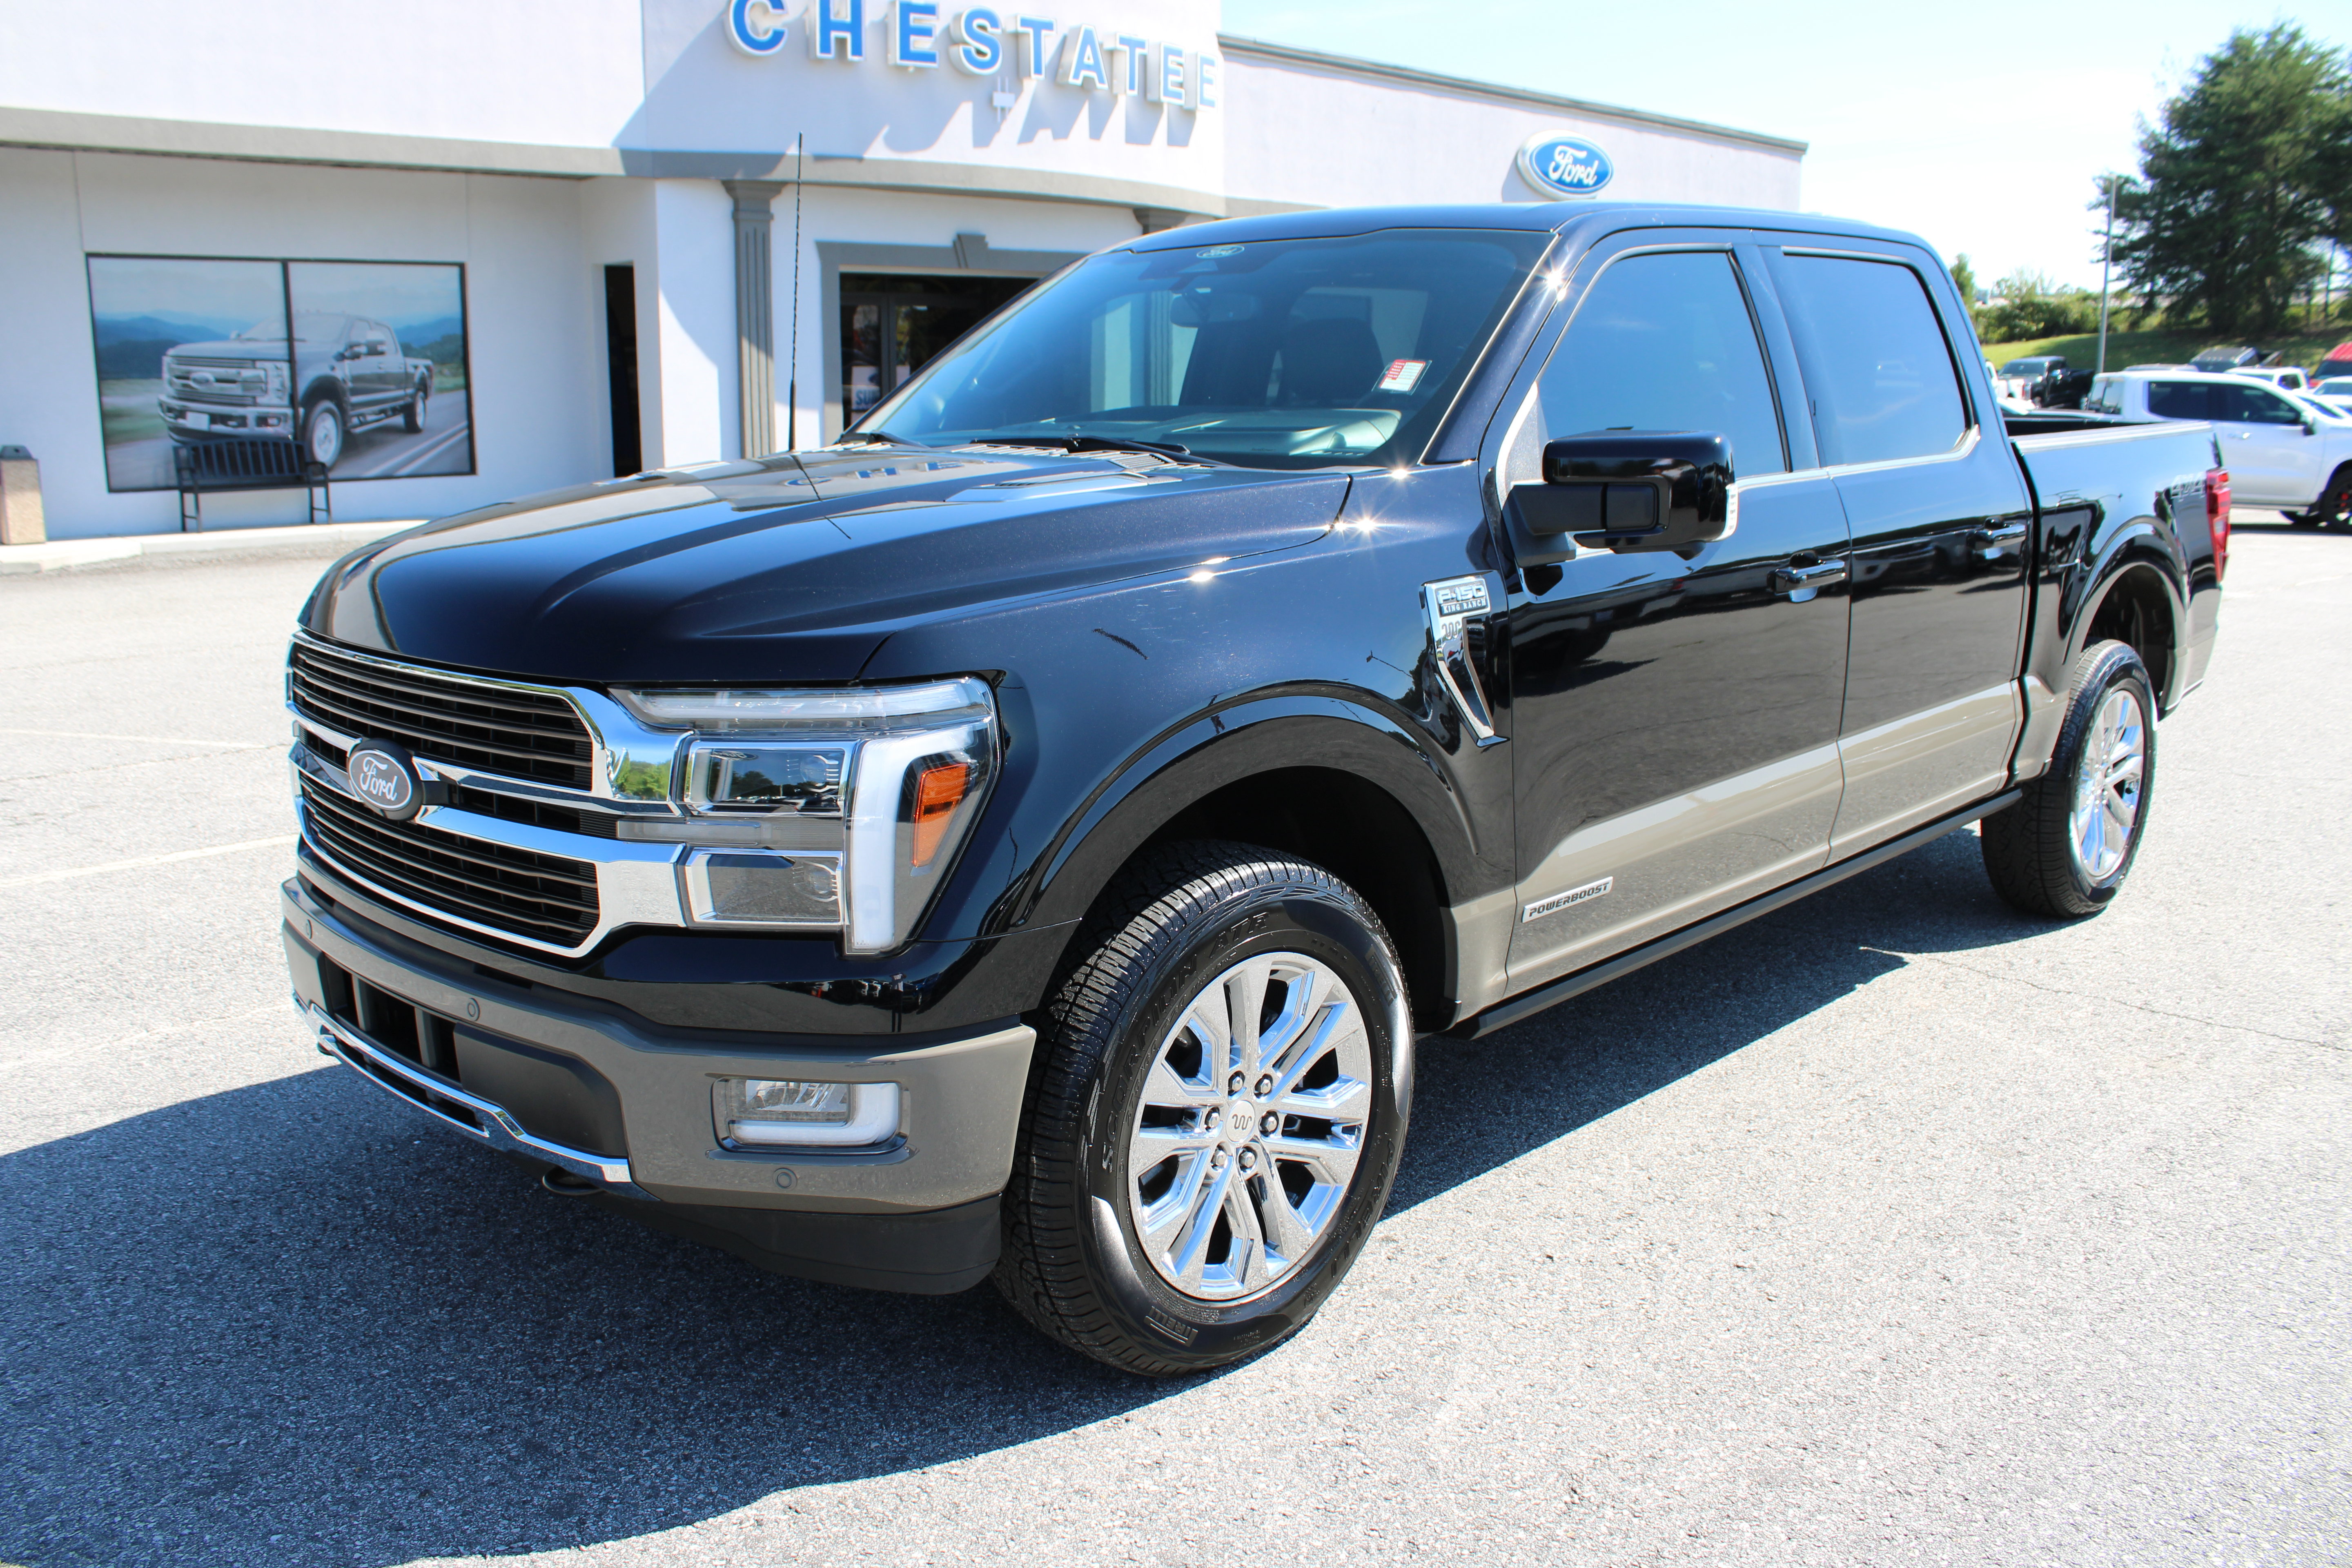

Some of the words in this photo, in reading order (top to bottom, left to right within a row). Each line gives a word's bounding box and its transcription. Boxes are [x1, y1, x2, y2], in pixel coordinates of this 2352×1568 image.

[728, 0, 1218, 109] CHESTATEE
[1548, 145, 1599, 187] Ford
[1437, 584, 1486, 605] F-150
[1443, 604, 1461, 614] KING
[1463, 597, 1487, 610] RANCH
[360, 756, 398, 801] Ford
[1528, 881, 1610, 918] POWERBOOST
[1102, 954, 1197, 1173] SCORPION
[1209, 911, 1270, 959] ATR
[1143, 1305, 1199, 1347] PIRELLI
